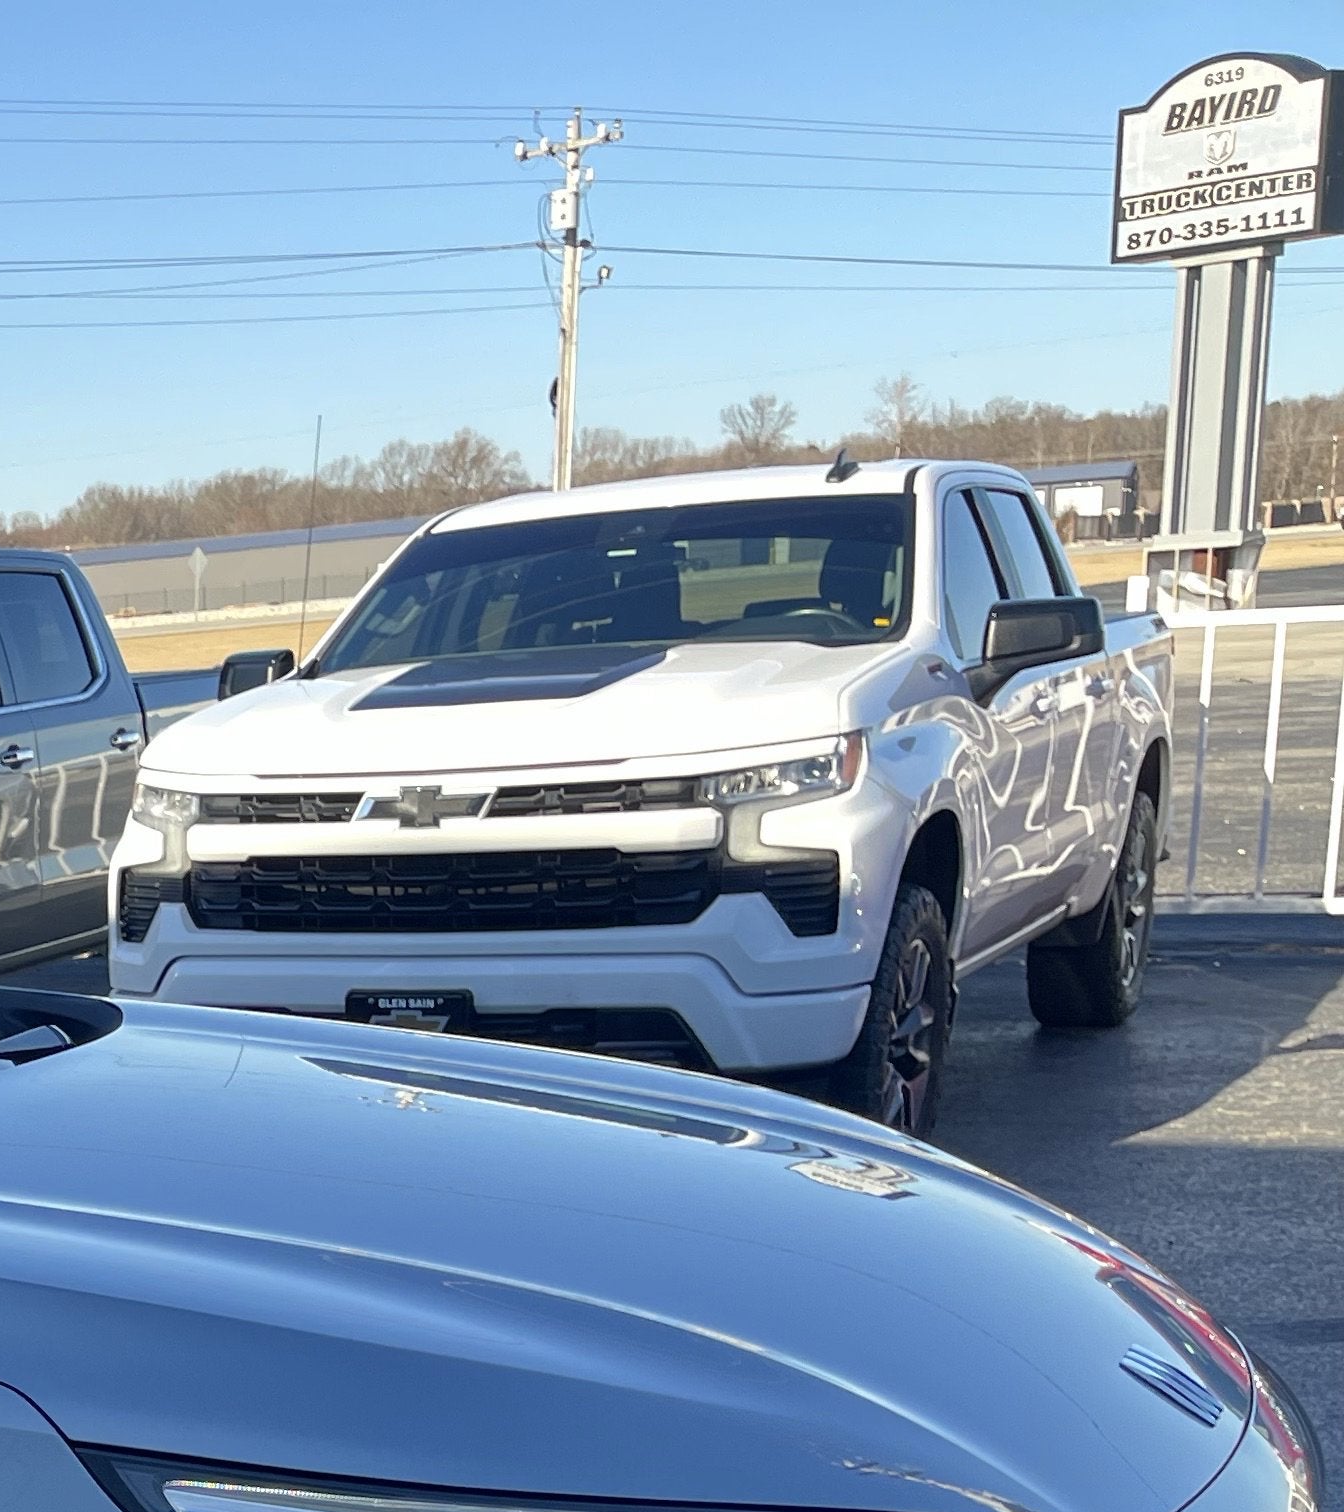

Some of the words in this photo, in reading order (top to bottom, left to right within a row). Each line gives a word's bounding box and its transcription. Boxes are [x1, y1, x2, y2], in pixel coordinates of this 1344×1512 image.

[1204, 67, 1245, 87] 6319
[1164, 84, 1283, 133] BAYIRD
[1187, 162, 1249, 180] RAM
[1125, 187, 1212, 218] TRUCK
[1216, 172, 1313, 199] CENTER
[1126, 207, 1306, 251] 870-335-1111
[378, 998, 406, 1009] GLEN
[409, 998, 435, 1009] SAIN
